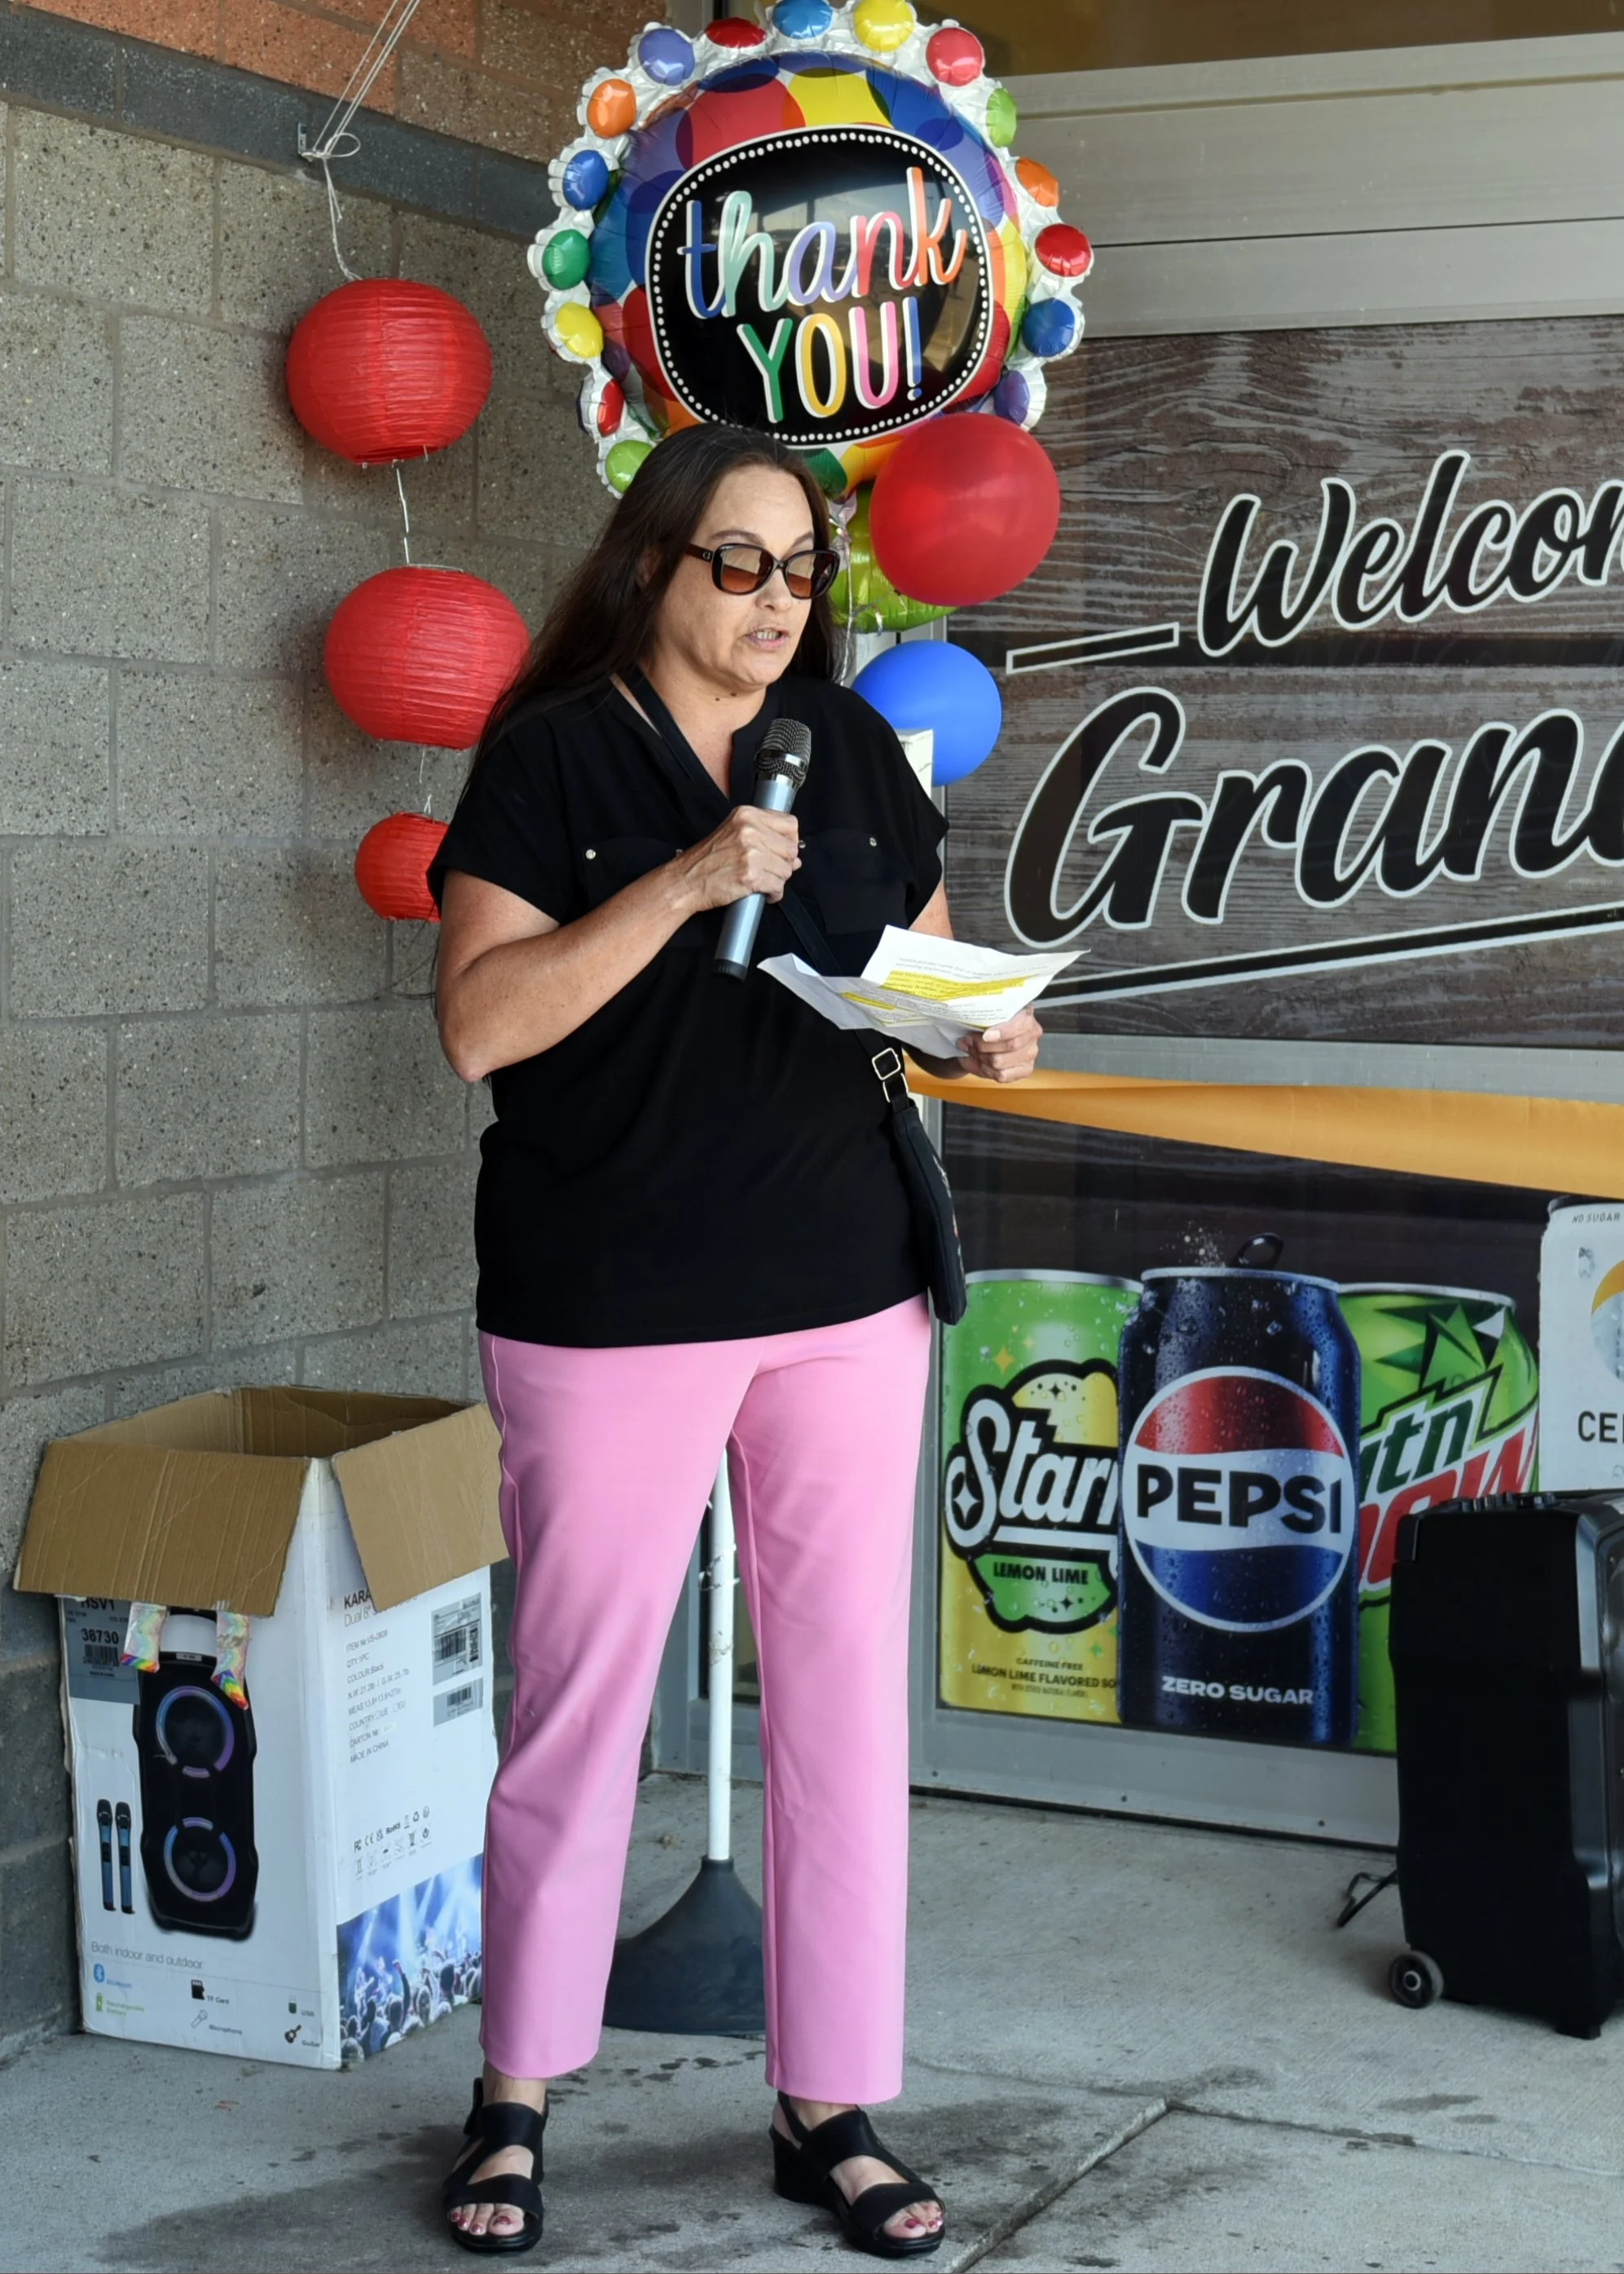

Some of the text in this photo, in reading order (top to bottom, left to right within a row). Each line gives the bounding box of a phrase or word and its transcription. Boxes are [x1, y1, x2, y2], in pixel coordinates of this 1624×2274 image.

[676, 166, 966, 319] thank
[736, 296, 922, 424] YOU!
[1572, 1212, 1620, 1224] NO SUGAR
[1578, 1411, 1624, 1444] CE
[1138, 1464, 1341, 1534] PEPSI
[993, 1562, 1088, 1585] LEMON LIME
[344, 1589, 372, 1609] KARA
[344, 1609, 362, 1627] Dual
[82, 1628, 119, 1644] 38730
[1016, 1658, 1083, 1670] CAFFEINE FREE
[1009, 1669, 1036, 1682] LIME
[1039, 1673, 1099, 1687] FLAVORED
[1102, 1678, 1116, 1688] SO
[1162, 1676, 1314, 1704] ZERO SUGAR
[91, 1941, 203, 1968] Both indoor and outdoor
